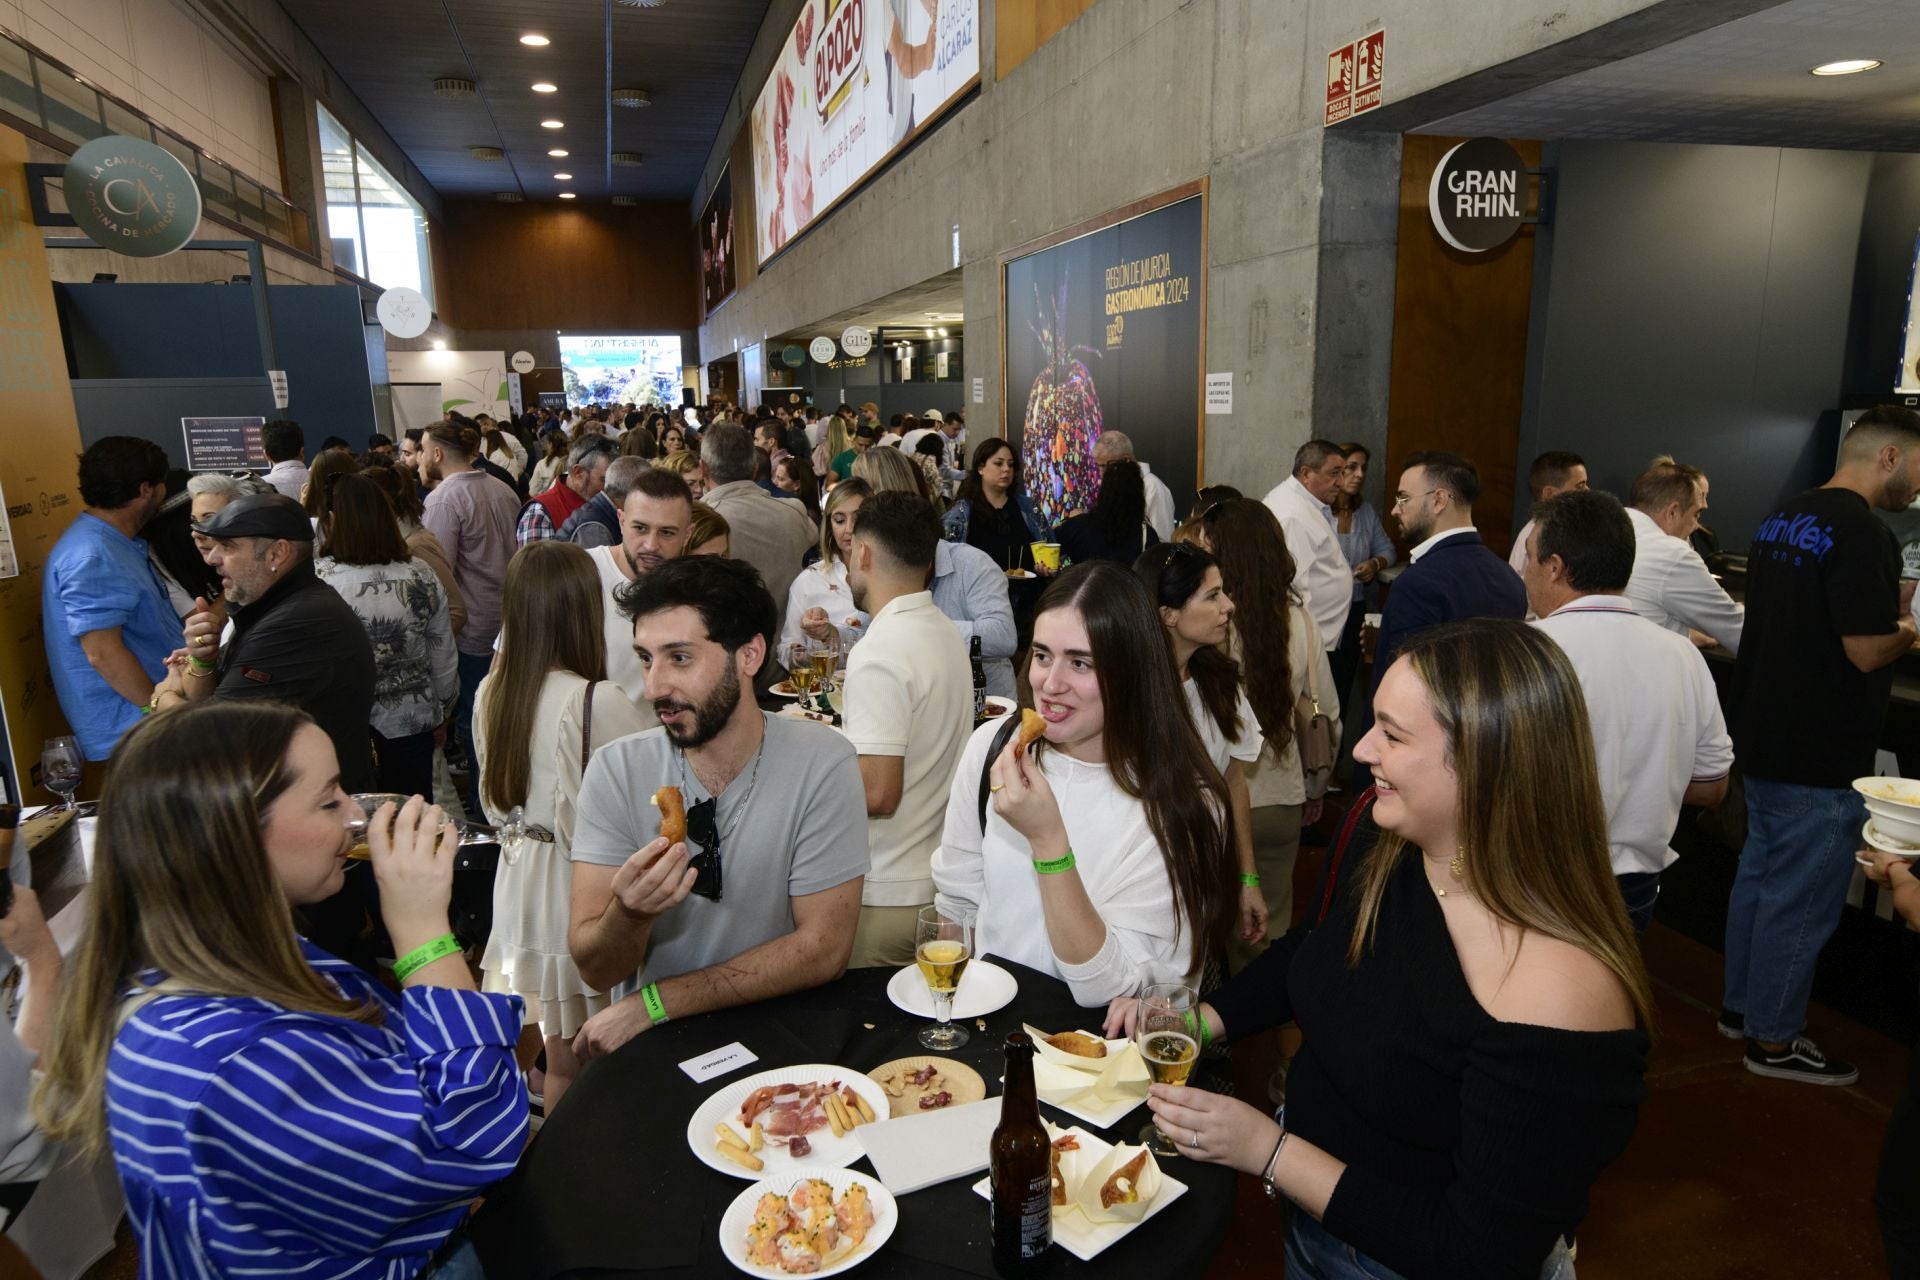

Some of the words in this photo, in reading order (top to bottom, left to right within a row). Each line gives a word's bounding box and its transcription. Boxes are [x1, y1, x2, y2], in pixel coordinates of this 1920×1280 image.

[937, 17, 973, 75] ALCARAZ
[1329, 101, 1342, 113] BOCA
[1342, 98, 1349, 108] DE
[1355, 89, 1381, 109] EXTINTOR
[1327, 107, 1350, 121] INCENDIO
[90, 166, 105, 180] LA
[1447, 170, 1517, 194] GRAN
[86, 191, 118, 232] COCINA
[122, 228, 139, 238] DE
[143, 192, 177, 237] MERCADO
[1456, 194, 1520, 218] RHIN.
[1105, 258, 1130, 290] REGIÓN
[1131, 260, 1140, 284] DE
[1141, 252, 1171, 281] MURCIA
[1166, 276, 1189, 304] 2024
